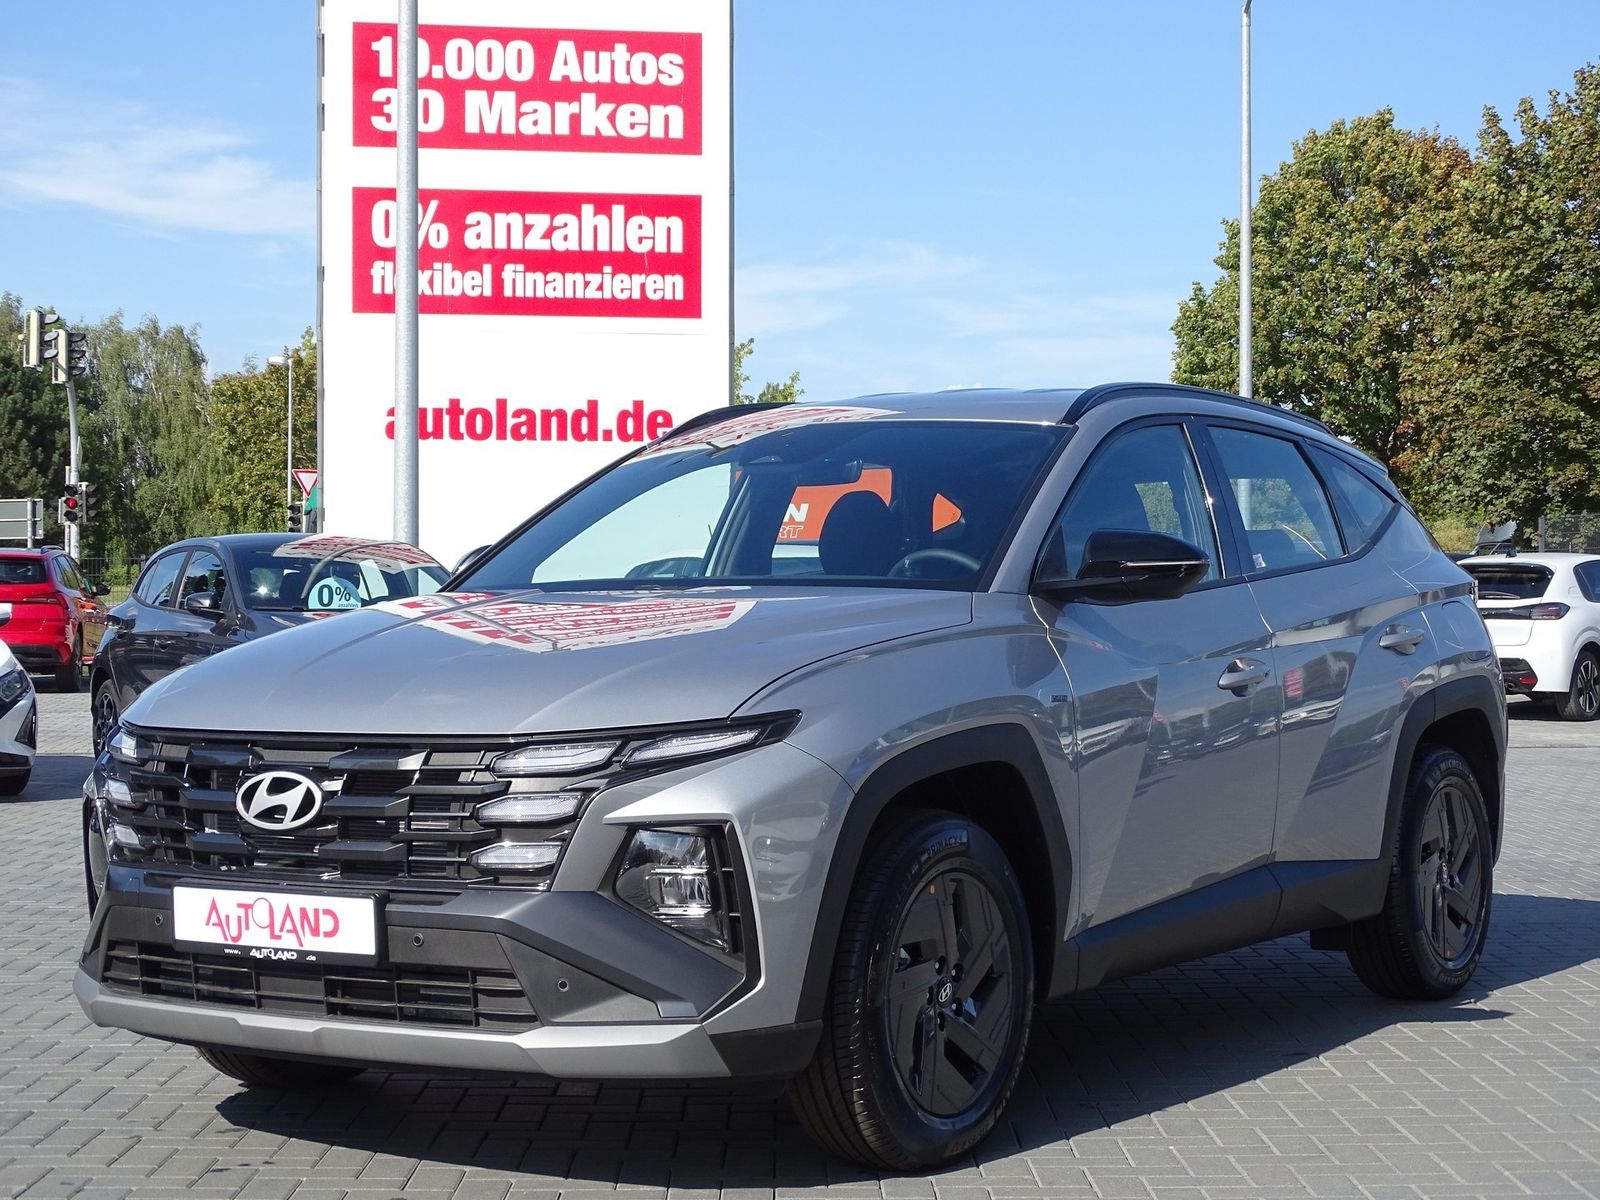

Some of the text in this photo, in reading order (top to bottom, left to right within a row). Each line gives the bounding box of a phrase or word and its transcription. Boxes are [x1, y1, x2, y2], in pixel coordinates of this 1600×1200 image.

[549, 40, 685, 86] Autos
[371, 88, 684, 139] 30 Marken
[371, 199, 684, 254] 0% anzahlen
[371, 261, 684, 300] flxibel finanzieren
[317, 584, 351, 607] 0%
[205, 896, 340, 947] AUTOLAND
[249, 948, 297, 961] AUTOLAND
